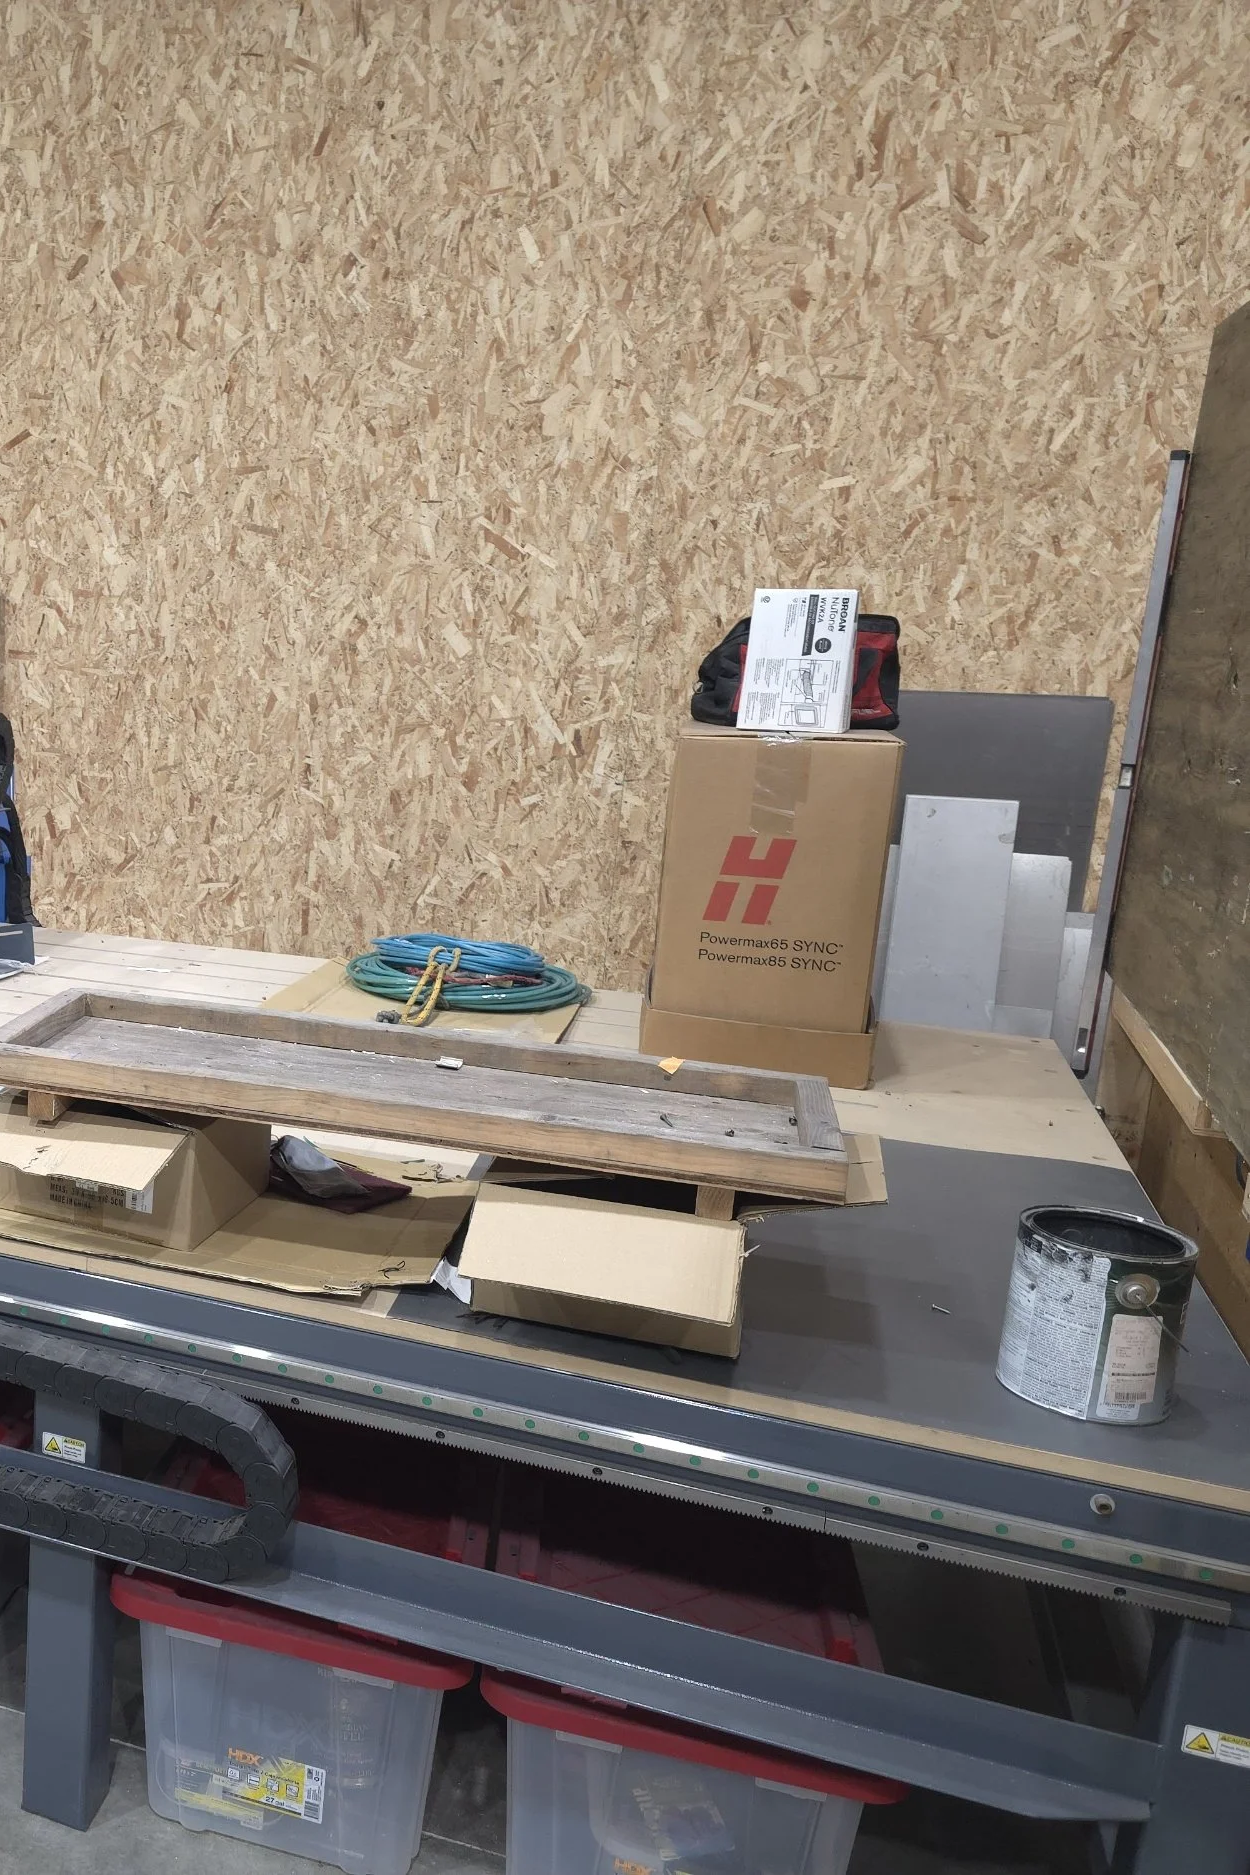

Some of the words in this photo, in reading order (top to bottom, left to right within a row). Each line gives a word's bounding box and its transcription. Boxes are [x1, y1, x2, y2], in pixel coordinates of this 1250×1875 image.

[817, 597, 827, 623] WVK2A
[838, 597, 850, 632] BROAN
[700, 931, 789, 950] Powermax65
[698, 949, 787, 968] Powermax85
[228, 1747, 263, 1766] HDX
